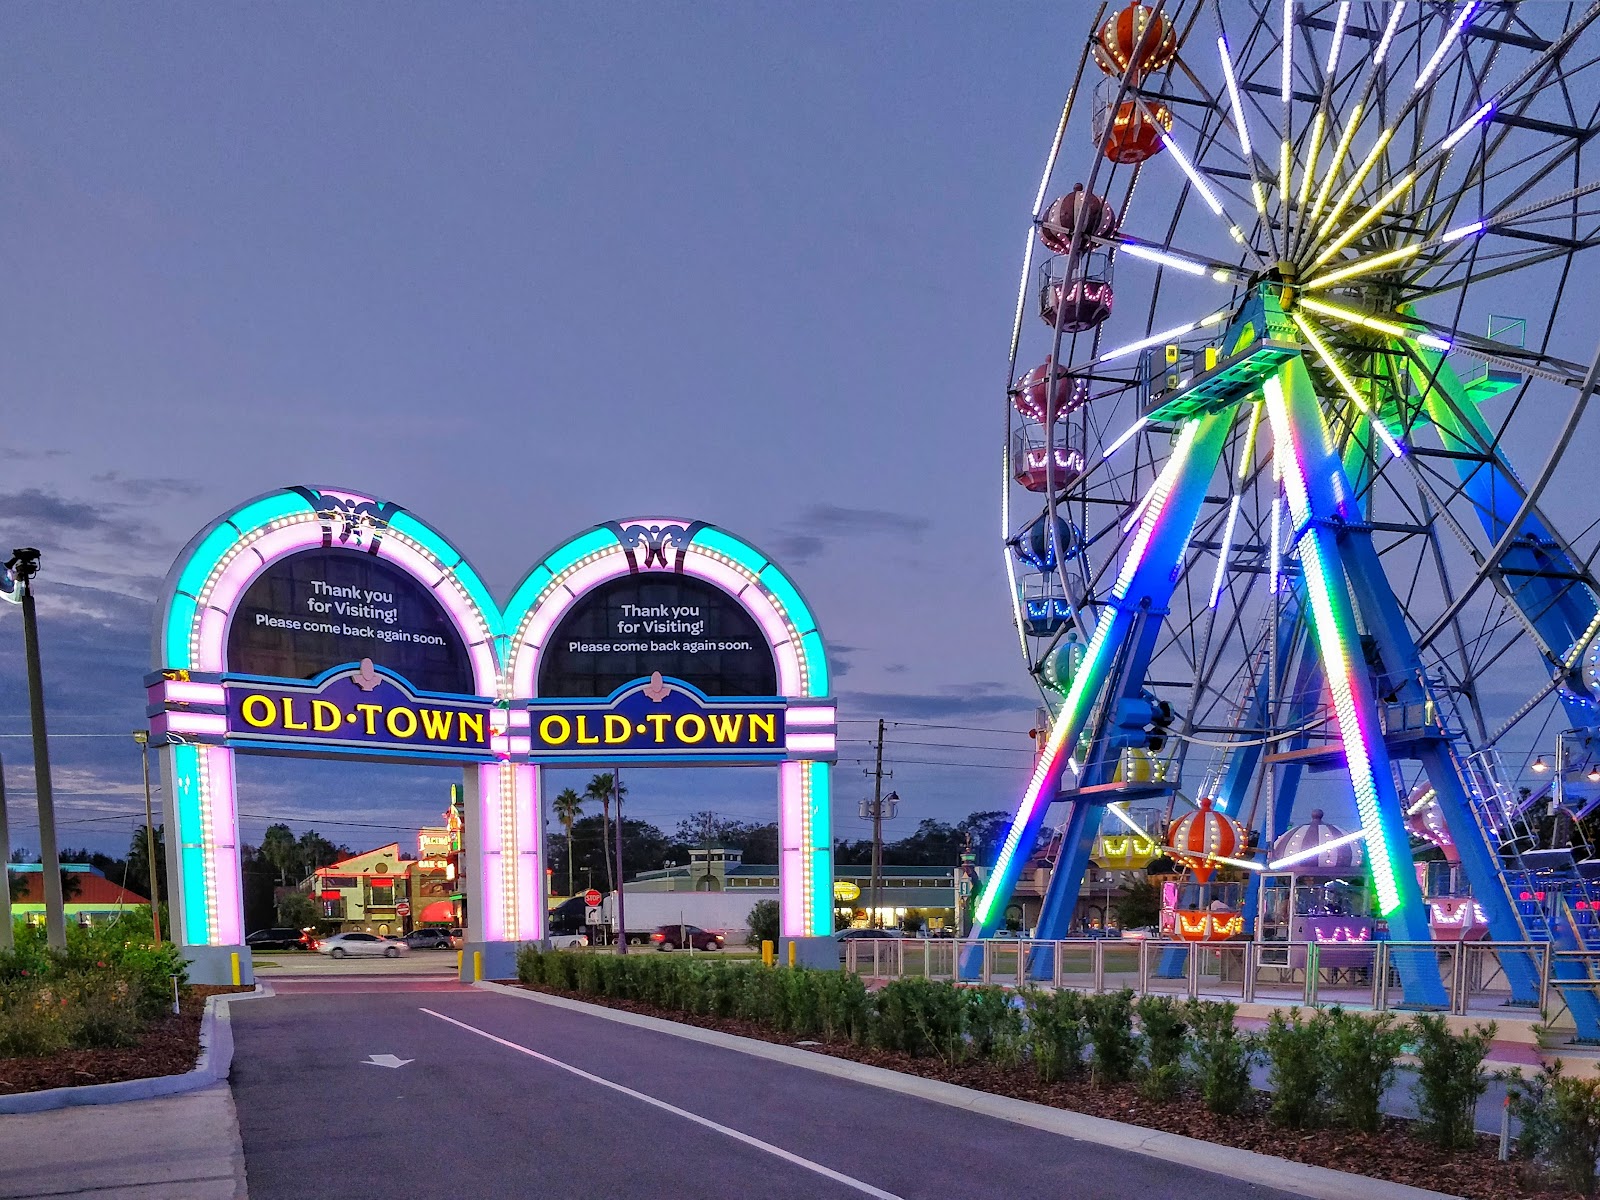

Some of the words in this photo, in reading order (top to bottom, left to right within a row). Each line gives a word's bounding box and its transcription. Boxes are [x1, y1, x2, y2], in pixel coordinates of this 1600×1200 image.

[311, 580, 361, 600] Thank
[364, 589, 393, 604] you
[307, 598, 332, 614] for
[336, 601, 398, 624] Visiting!
[621, 604, 668, 618] Thank
[671, 606, 699, 620] you
[255, 613, 301, 631] Please
[303, 621, 341, 635] come
[342, 626, 375, 639] back
[376, 629, 411, 643] again
[412, 634, 447, 646] soon.
[617, 620, 640, 634] for
[642, 620, 704, 636] Visiting!
[569, 641, 611, 652] Please
[612, 641, 648, 652] come
[650, 639, 681, 651] back
[682, 640, 716, 653] again
[718, 641, 753, 651] soon.
[1447, 903, 1452, 911] 3
